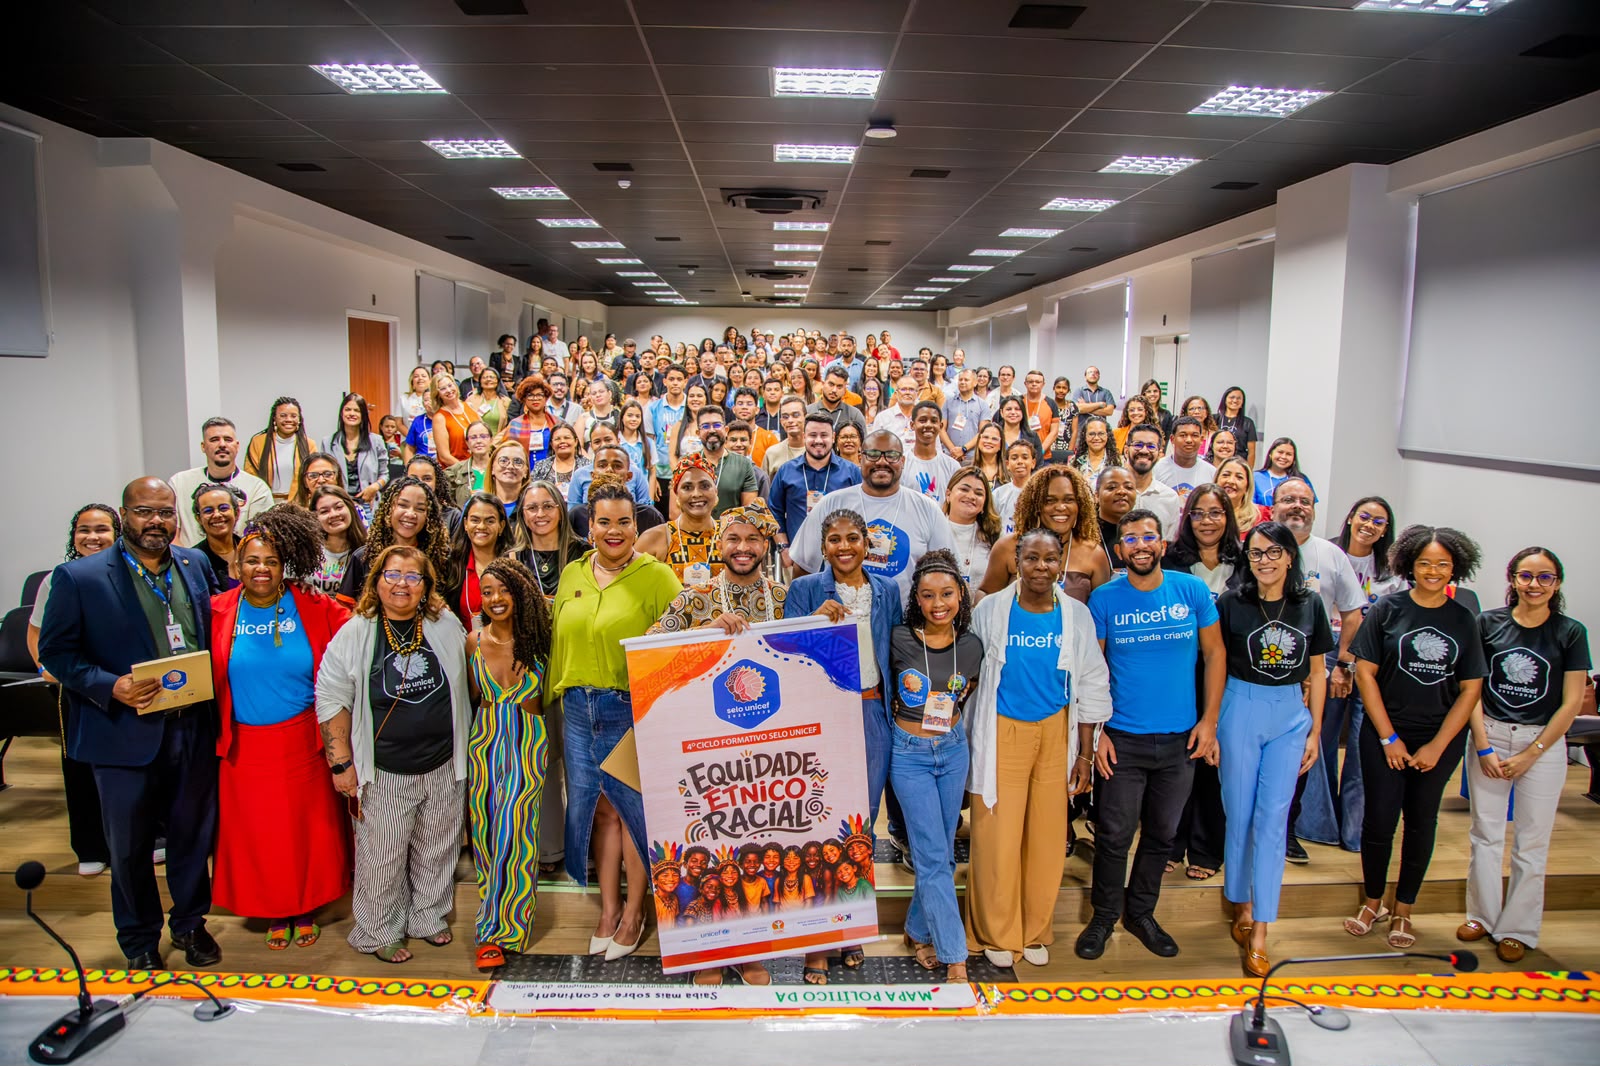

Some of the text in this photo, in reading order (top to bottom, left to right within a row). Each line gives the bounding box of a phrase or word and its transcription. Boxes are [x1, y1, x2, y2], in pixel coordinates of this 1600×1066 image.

[313, 579, 341, 592] NUC
[1114, 605, 1167, 626] unicef
[236, 619, 276, 635] nicef
[1007, 630, 1054, 648] nicef
[1137, 633, 1161, 642] cada
[411, 676, 435, 688] unicef
[1498, 683, 1538, 695] selo unicef
[726, 701, 770, 715] selo unicef
[696, 739, 720, 750] CICLO
[721, 733, 768, 747] FORMATIVO
[769, 729, 788, 740] SELO
[789, 726, 817, 737] UNICEF
[615, 992, 651, 1000] sobre
[655, 992, 682, 1000] mais
[685, 991, 718, 1000] Saiba
[775, 990, 933, 1005] MAPA POLÍTICO DA
